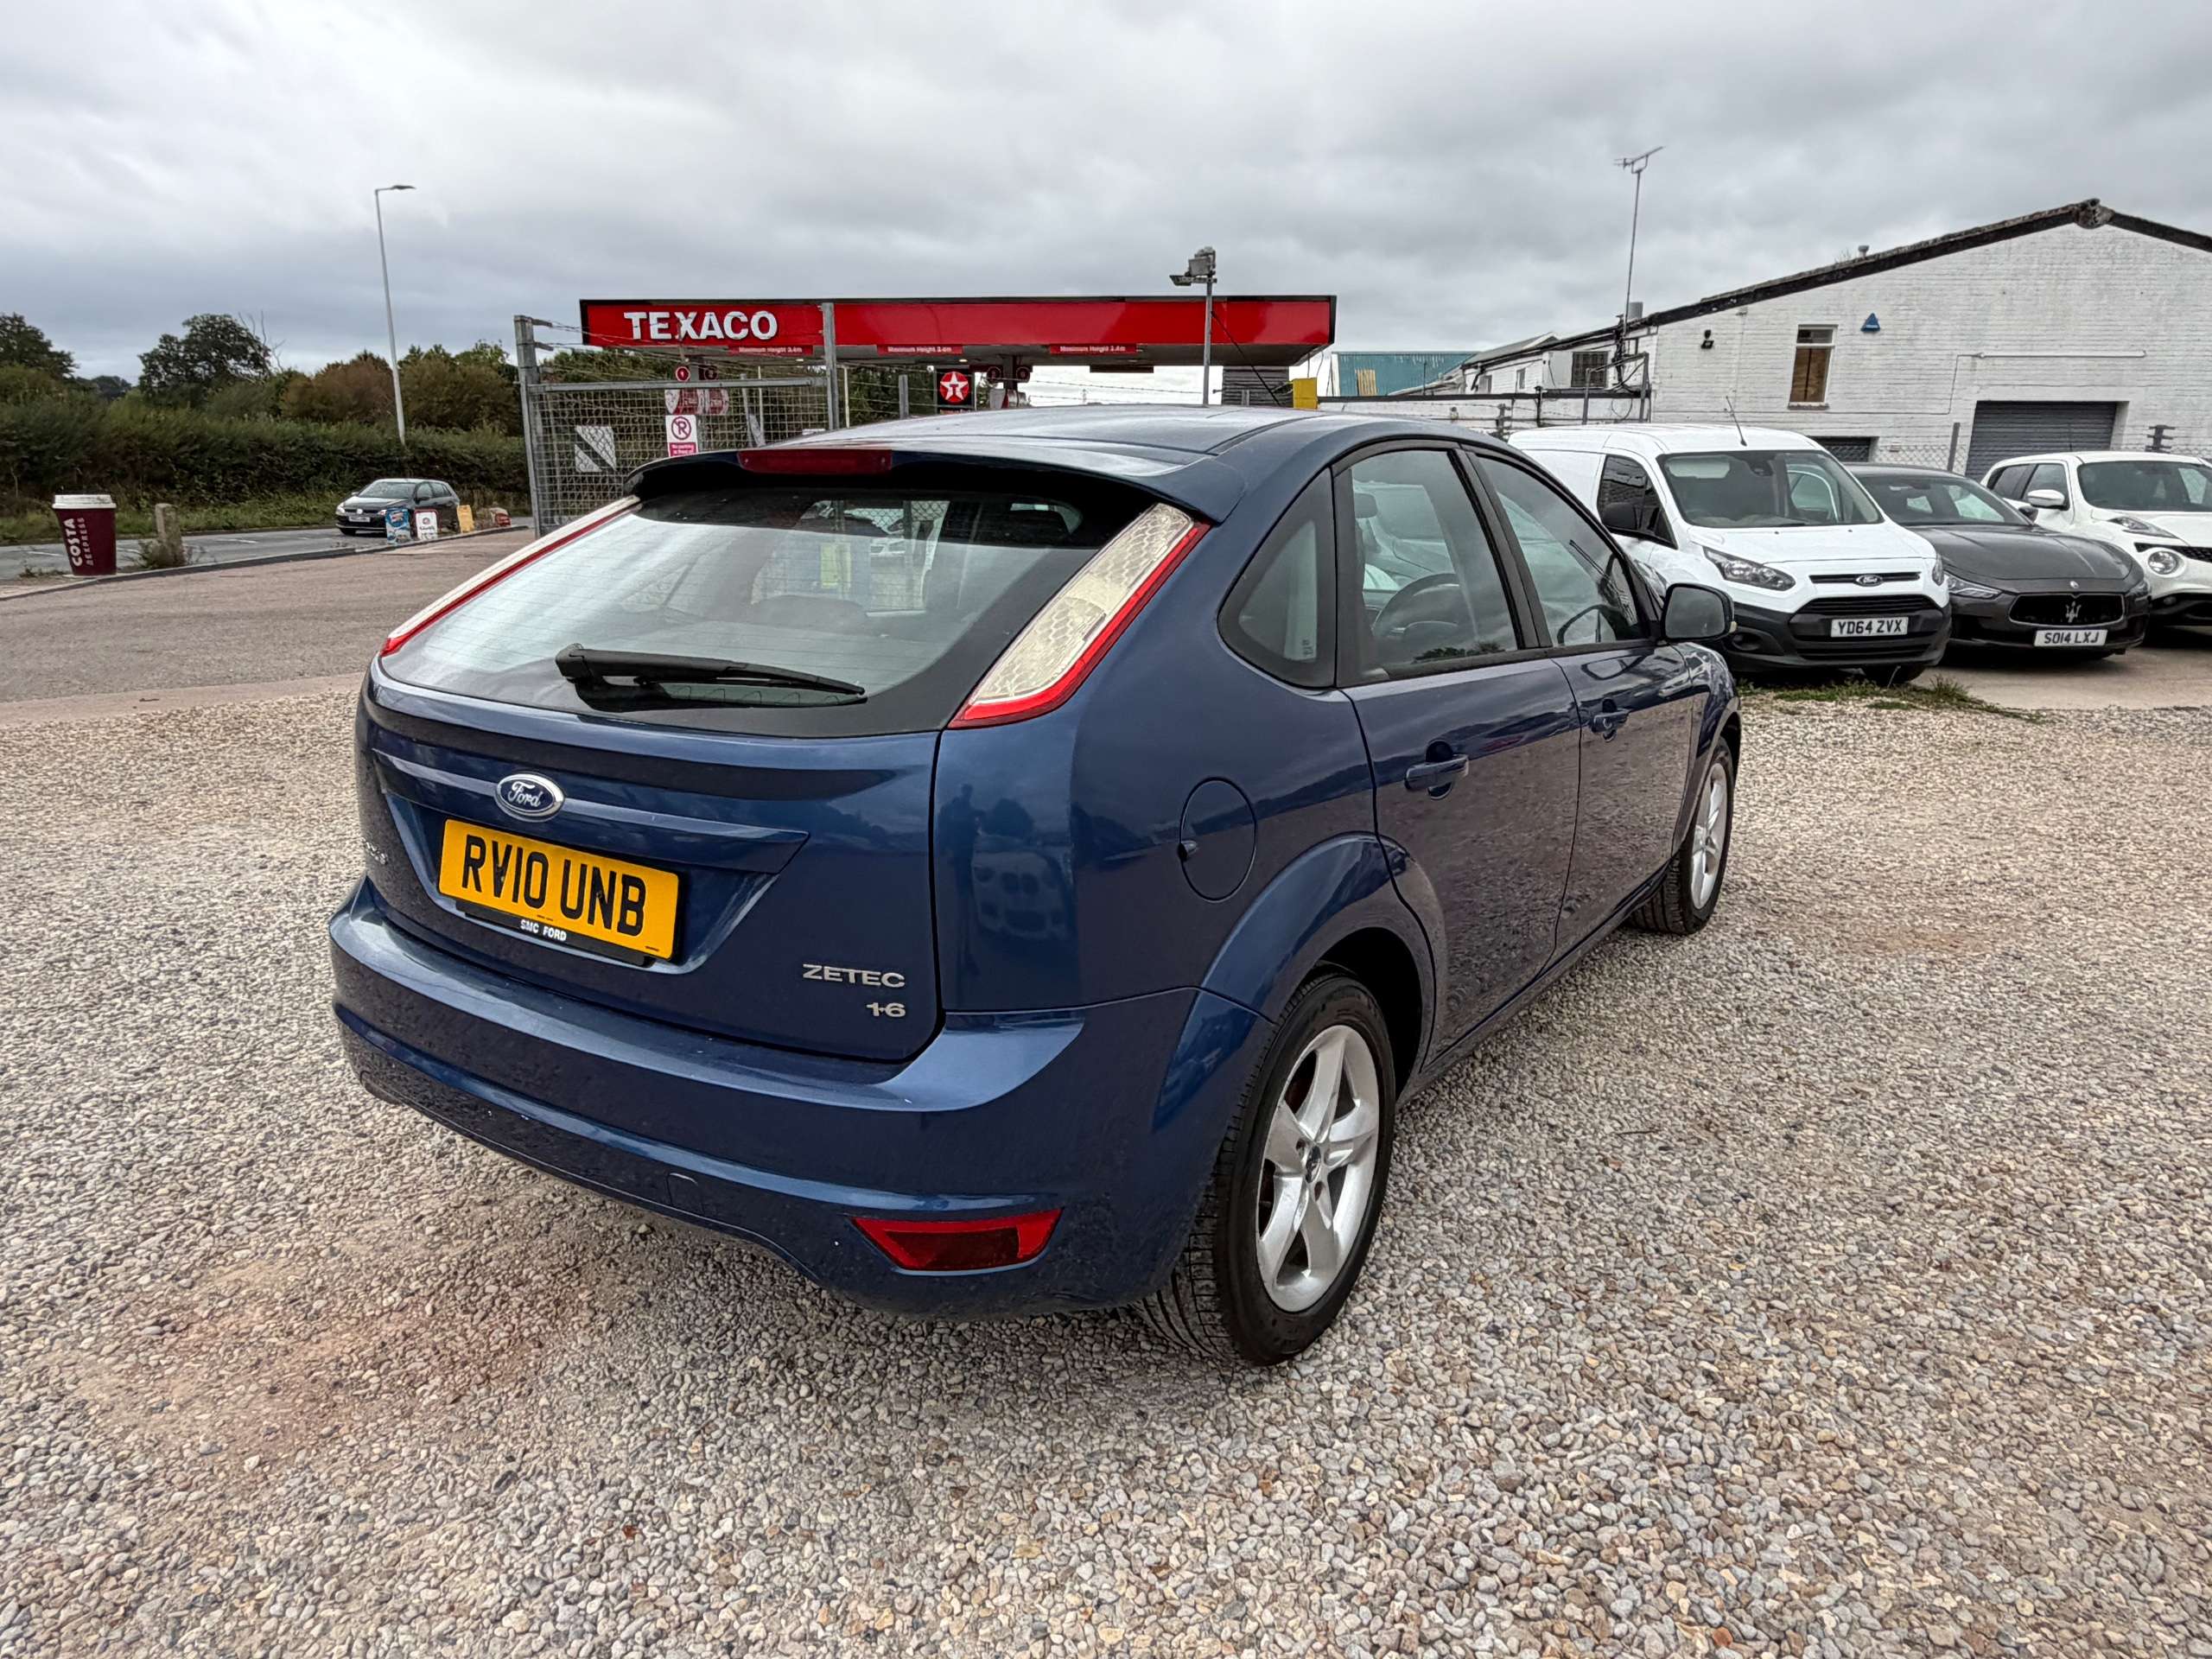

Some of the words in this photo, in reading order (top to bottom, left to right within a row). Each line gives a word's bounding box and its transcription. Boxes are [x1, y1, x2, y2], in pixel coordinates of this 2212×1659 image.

[623, 309, 779, 340] TEXACO
[63, 518, 83, 567] COSTA
[1838, 620, 1872, 634] YD64
[1876, 620, 1902, 633] ZVX
[2044, 632, 2071, 645] SO14
[2074, 631, 2100, 644] LXJ
[507, 780, 543, 808] Ford
[461, 834, 549, 909] RV10
[560, 859, 646, 937] UNB
[520, 918, 540, 934] SMC
[543, 925, 567, 942] FORD
[802, 963, 906, 988] ZETEC
